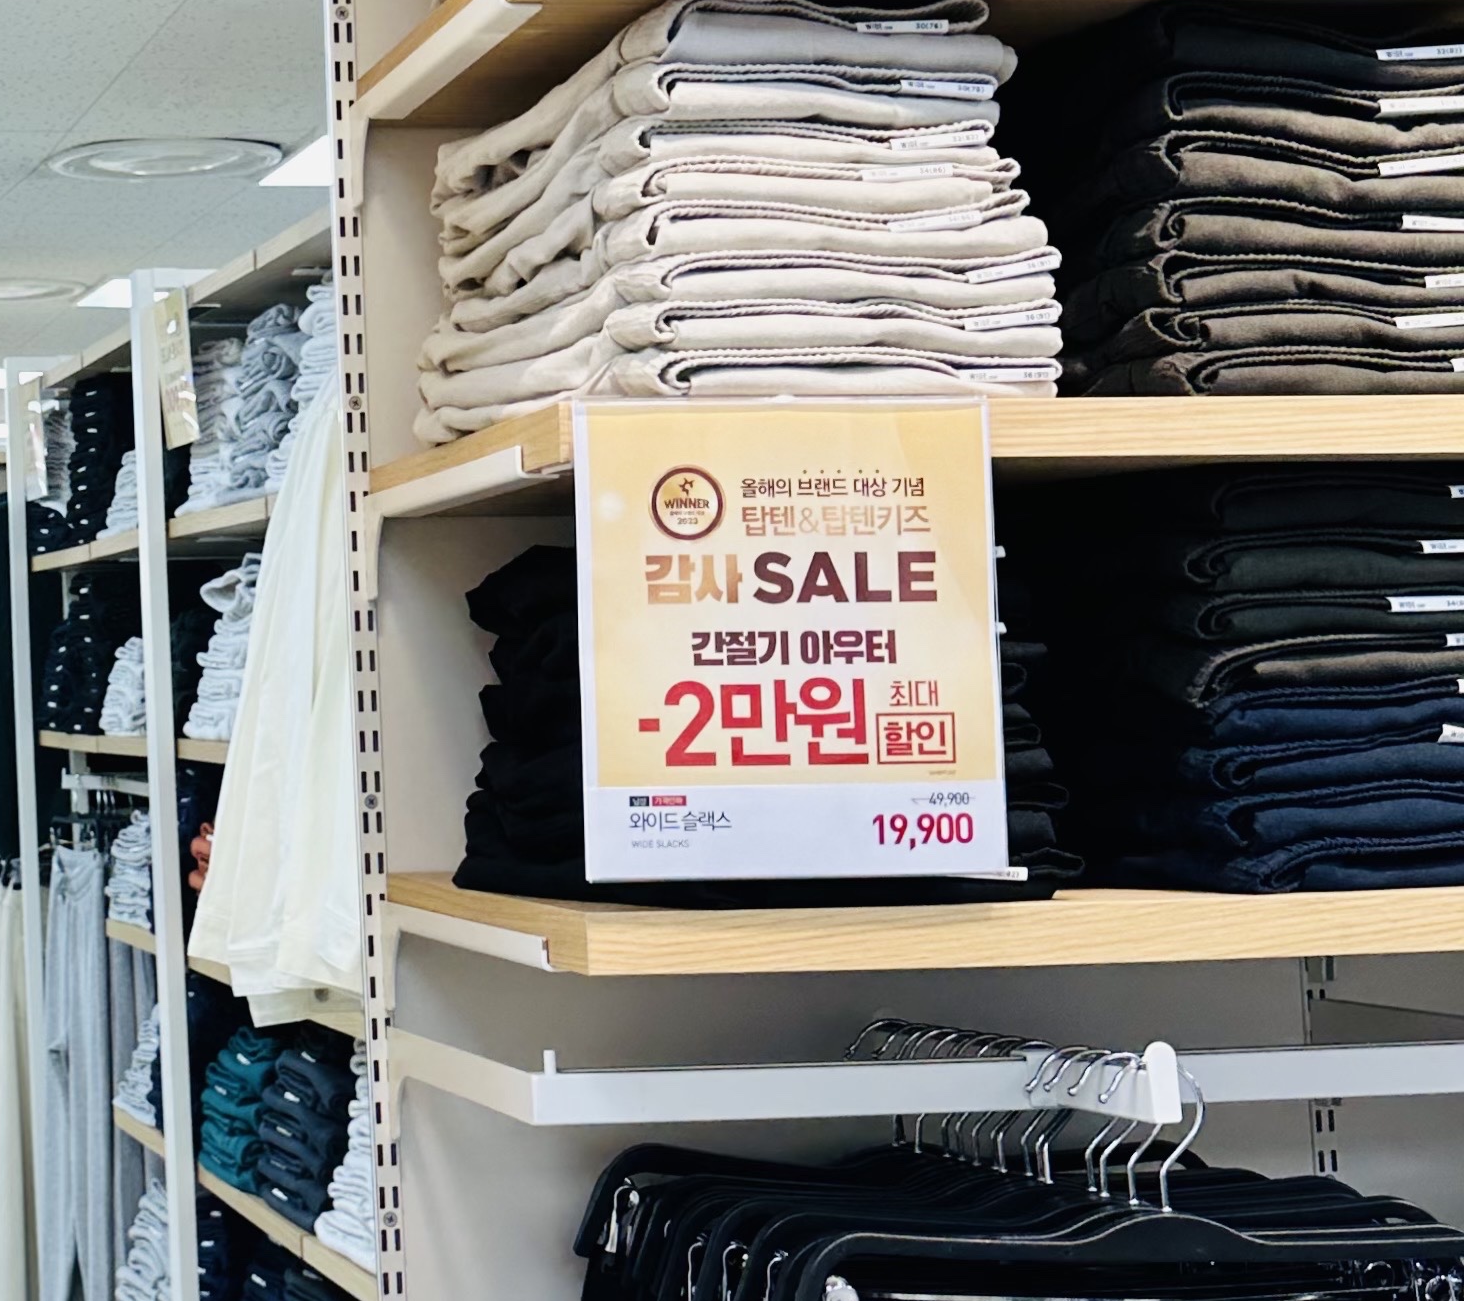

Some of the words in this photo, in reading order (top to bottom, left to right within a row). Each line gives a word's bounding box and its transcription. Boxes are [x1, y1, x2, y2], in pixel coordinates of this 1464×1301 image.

[740, 477, 792, 498] 올해의
[797, 477, 848, 497] 브랜드
[853, 477, 887, 497] 대상
[892, 477, 925, 497] 기념
[664, 498, 710, 509] WINNER
[741, 504, 931, 537] 탑텐&탑텐키즈
[645, 554, 743, 605] 감사
[753, 551, 938, 604] SALE
[691, 630, 790, 666] 간절기
[799, 629, 897, 665] 아우터
[889, 680, 939, 707] 최대
[638, 677, 869, 767] -2만원
[884, 720, 947, 756] 할인
[929, 792, 969, 807] 49,900
[629, 811, 680, 832] 와이드
[681, 811, 732, 831] 슬랙스
[872, 812, 974, 851] 19,900
[631, 839, 654, 848] WIDE
[656, 839, 690, 848] SLACKS
